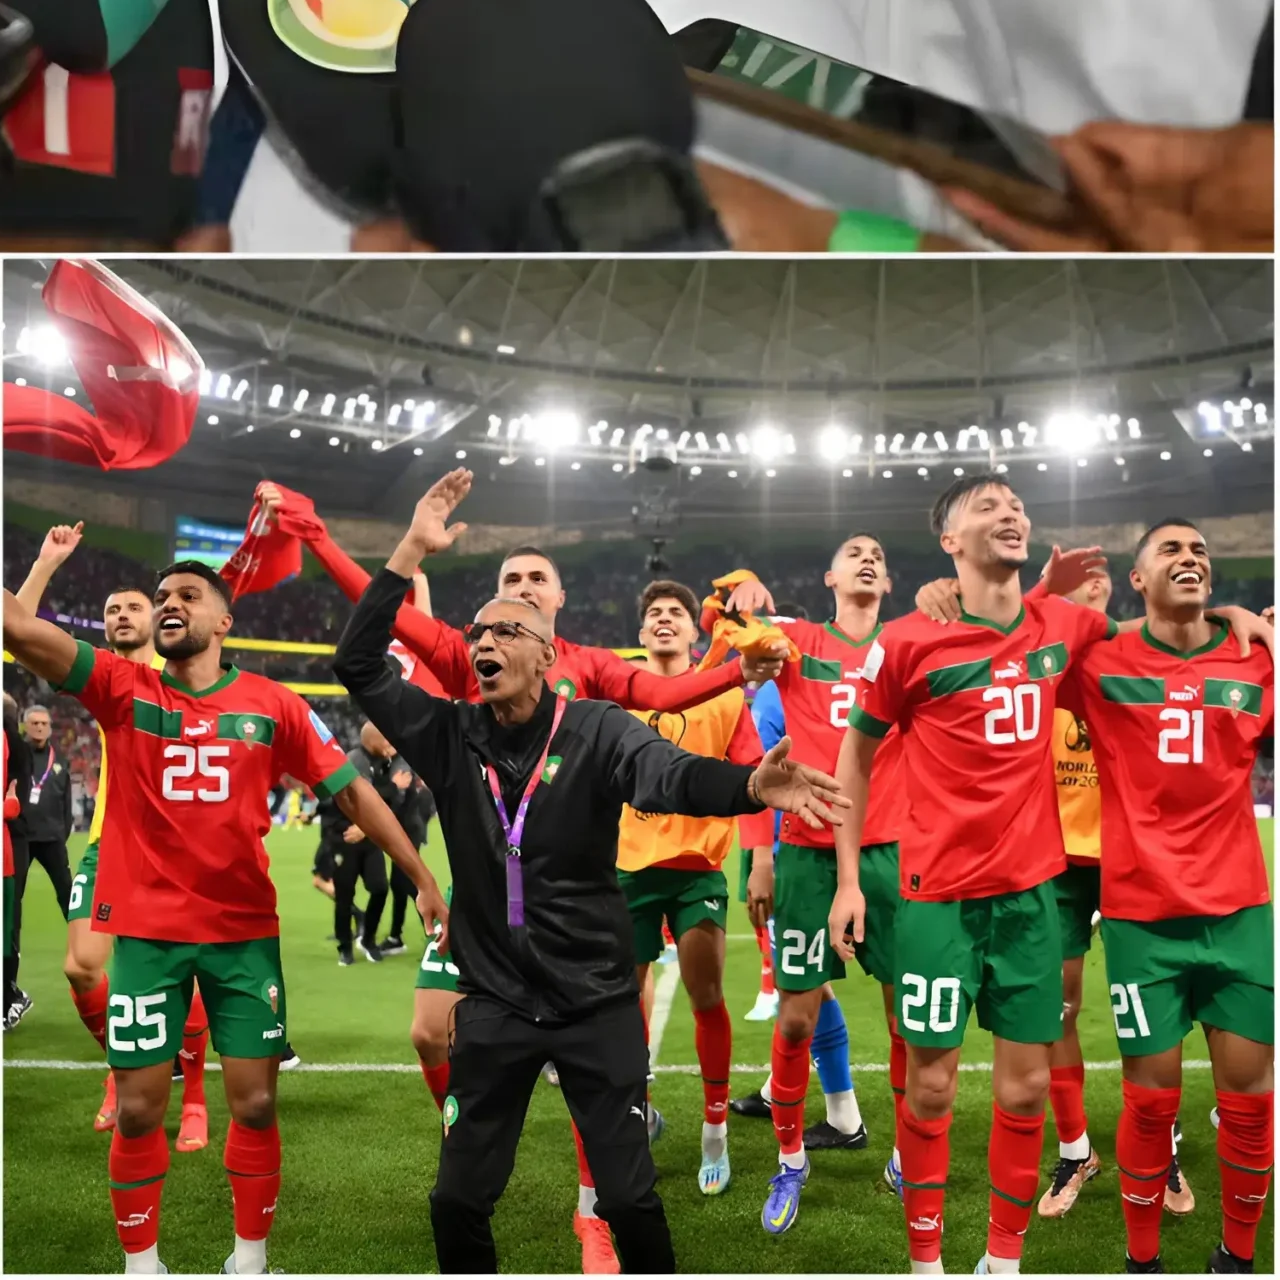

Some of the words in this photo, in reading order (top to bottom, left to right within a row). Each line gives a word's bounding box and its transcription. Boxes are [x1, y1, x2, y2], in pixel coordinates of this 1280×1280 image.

[830, 684, 857, 728] 2
[982, 683, 1041, 745] 20
[1157, 707, 1204, 764] 21
[162, 744, 230, 802] 25
[781, 927, 826, 975] 24
[108, 992, 167, 1052] 25
[901, 972, 961, 1033] 20
[1110, 983, 1151, 1039] 21
